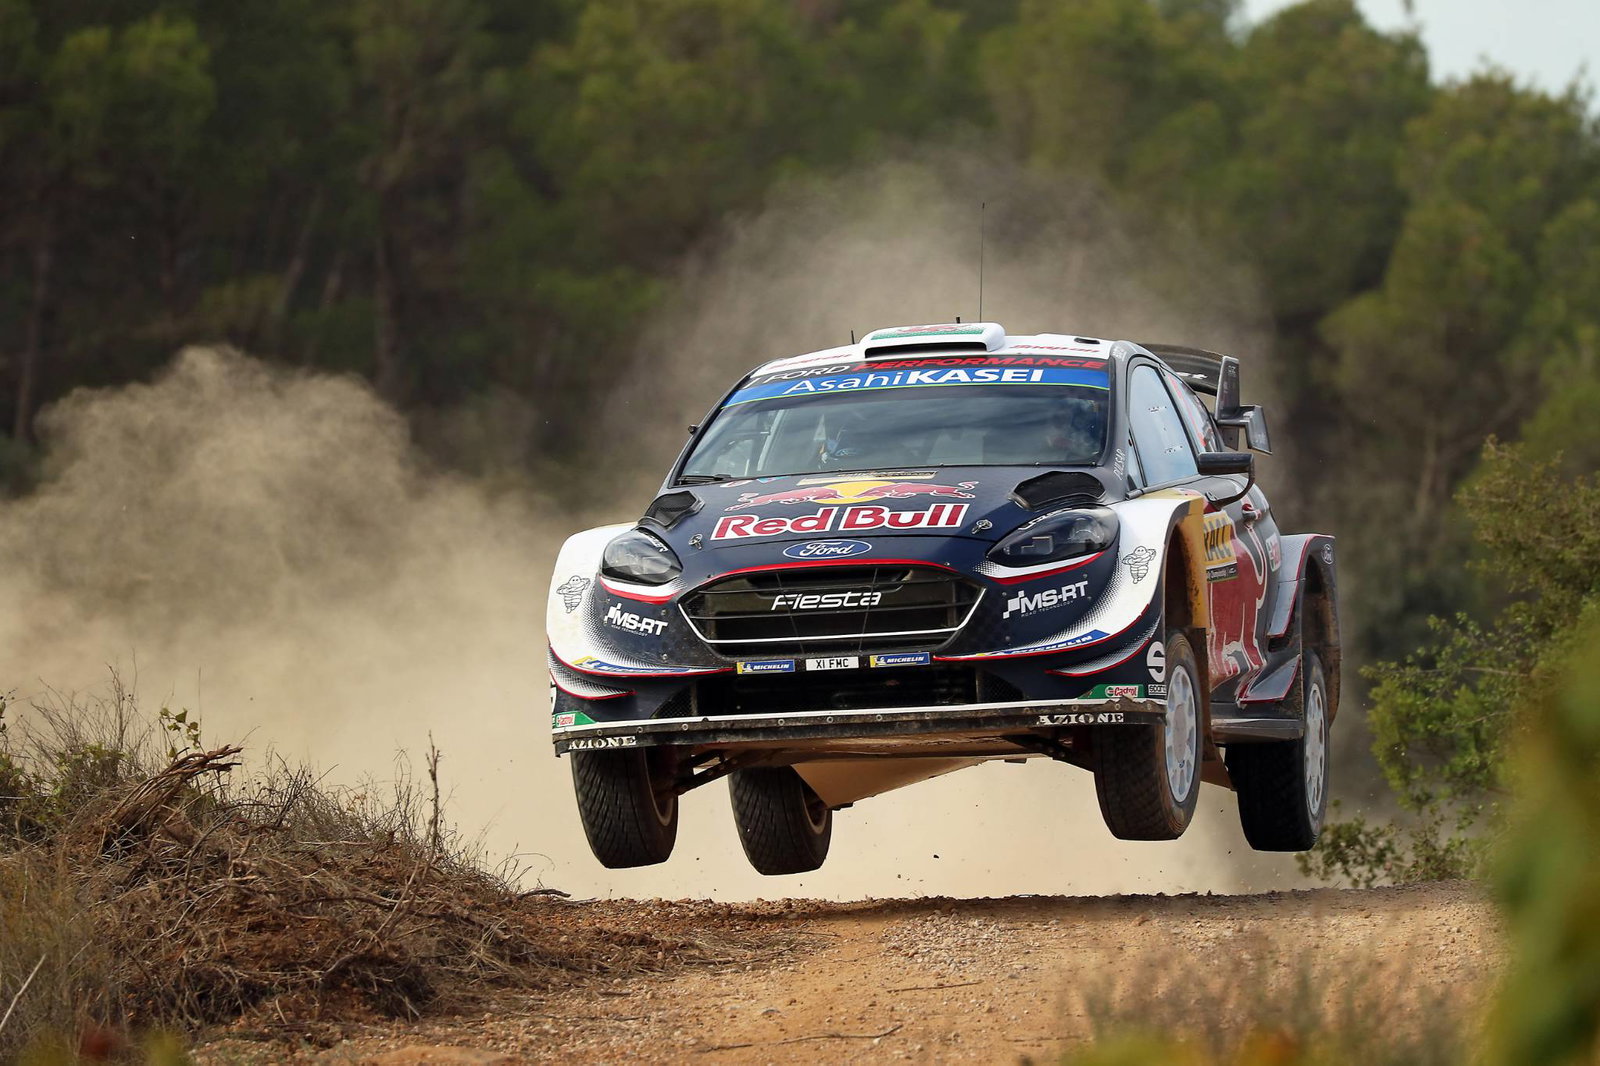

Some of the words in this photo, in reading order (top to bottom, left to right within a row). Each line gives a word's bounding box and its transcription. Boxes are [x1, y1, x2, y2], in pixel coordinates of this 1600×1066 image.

[764, 365, 850, 384] FORD
[852, 357, 1108, 372] PERFORMANCE
[710, 507, 839, 540] Red
[838, 503, 970, 530] Bull
[799, 542, 854, 556] Ford
[771, 591, 882, 610] Fiesta
[828, 658, 849, 669] FMC
[886, 656, 925, 664] MICHELIN
[753, 663, 790, 671] MICHELIN
[1114, 686, 1137, 697] Castrol
